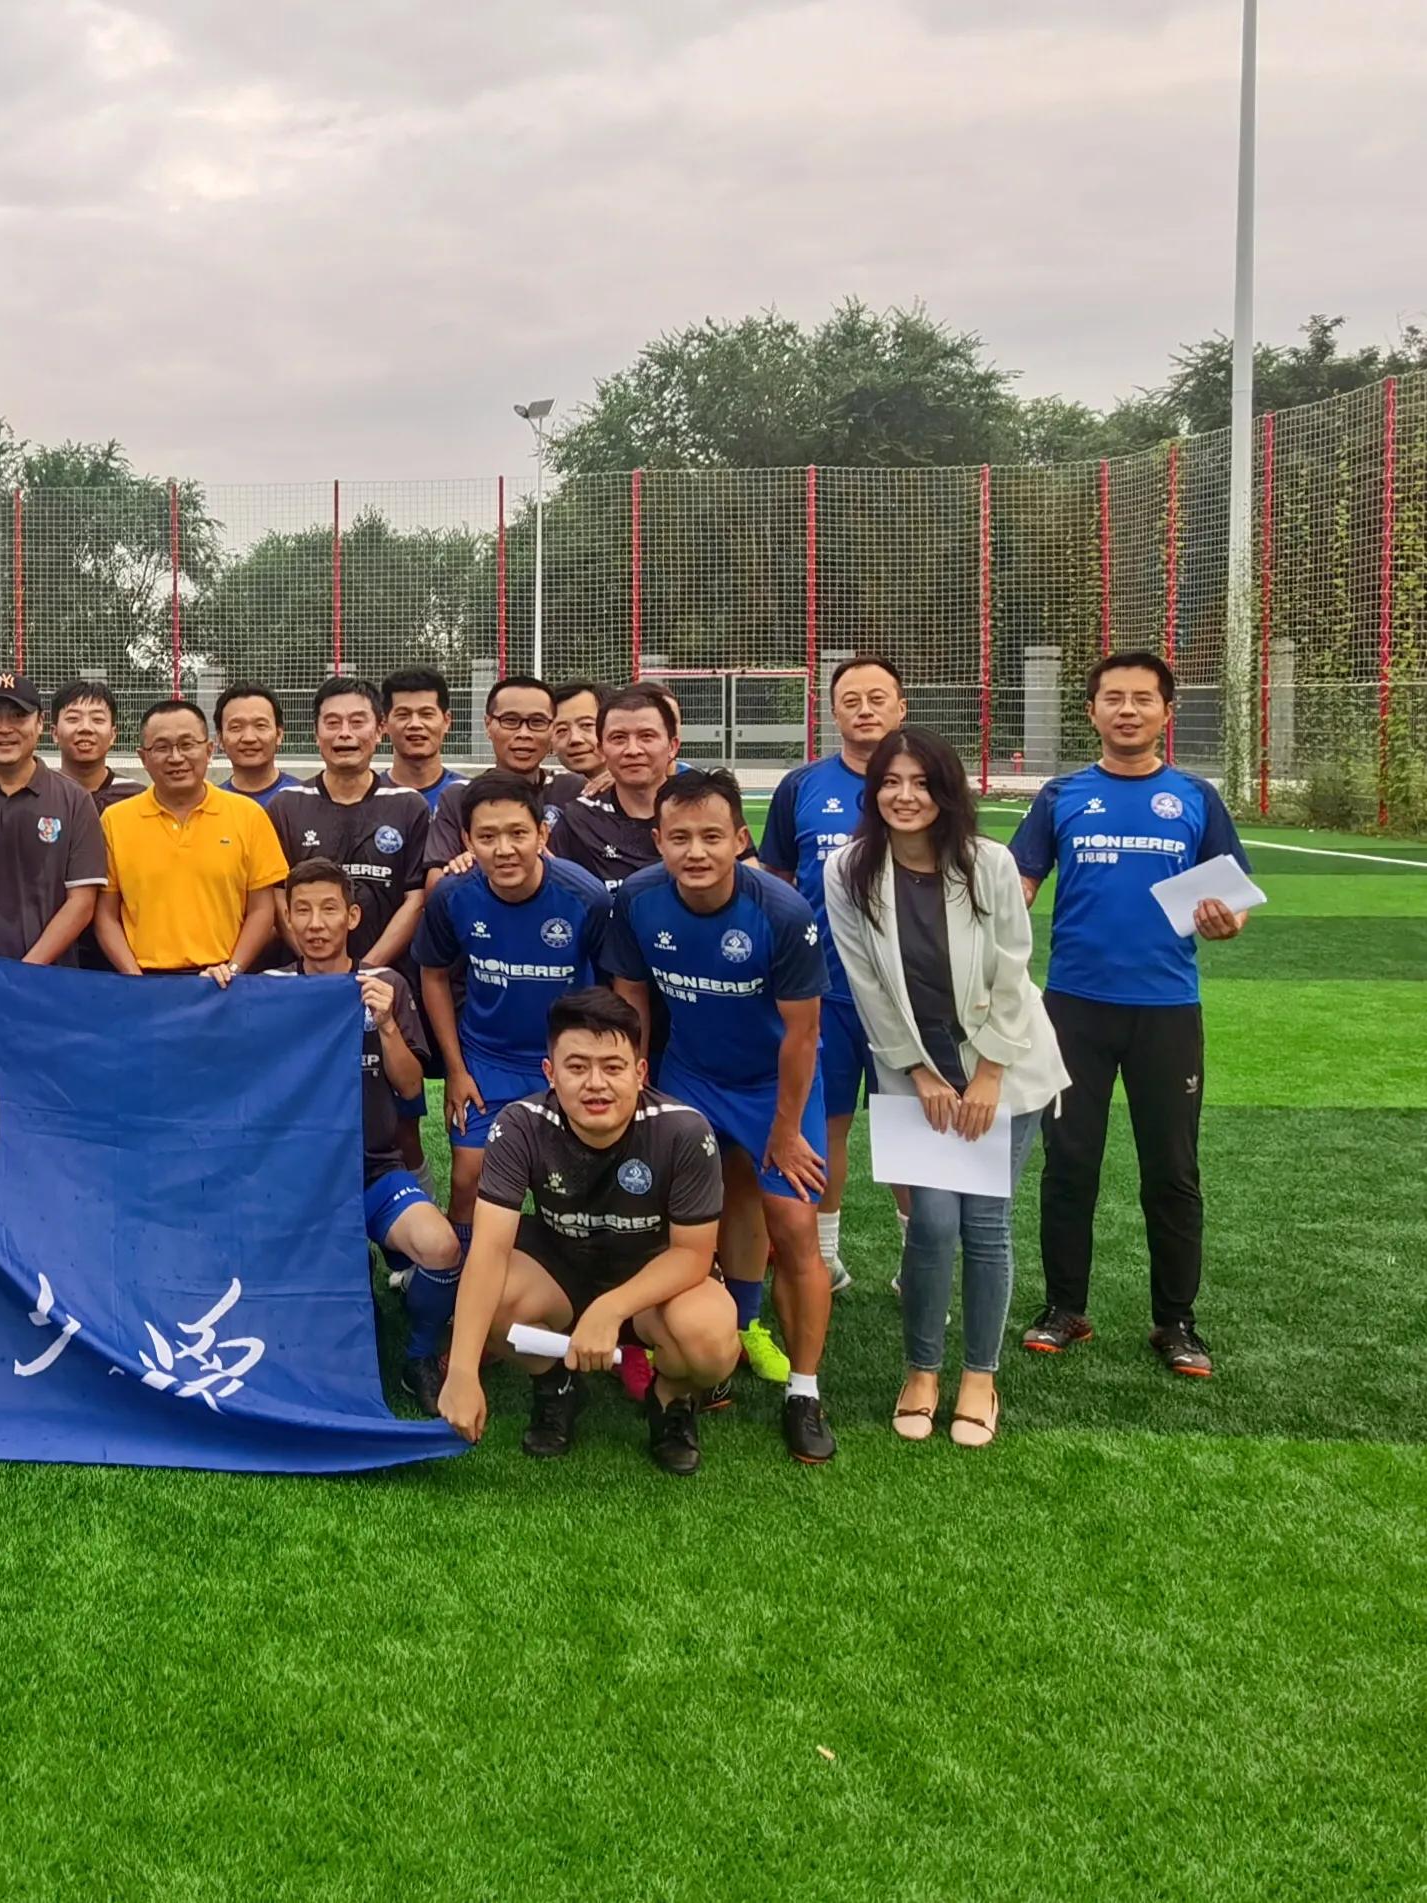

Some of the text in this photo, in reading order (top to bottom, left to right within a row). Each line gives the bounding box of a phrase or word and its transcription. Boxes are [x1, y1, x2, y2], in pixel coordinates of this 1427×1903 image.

[1072, 834, 1186, 853] PIONEEREP
[469, 954, 575, 977] PIONEEREP
[652, 966, 764, 993] PIONEEREP
